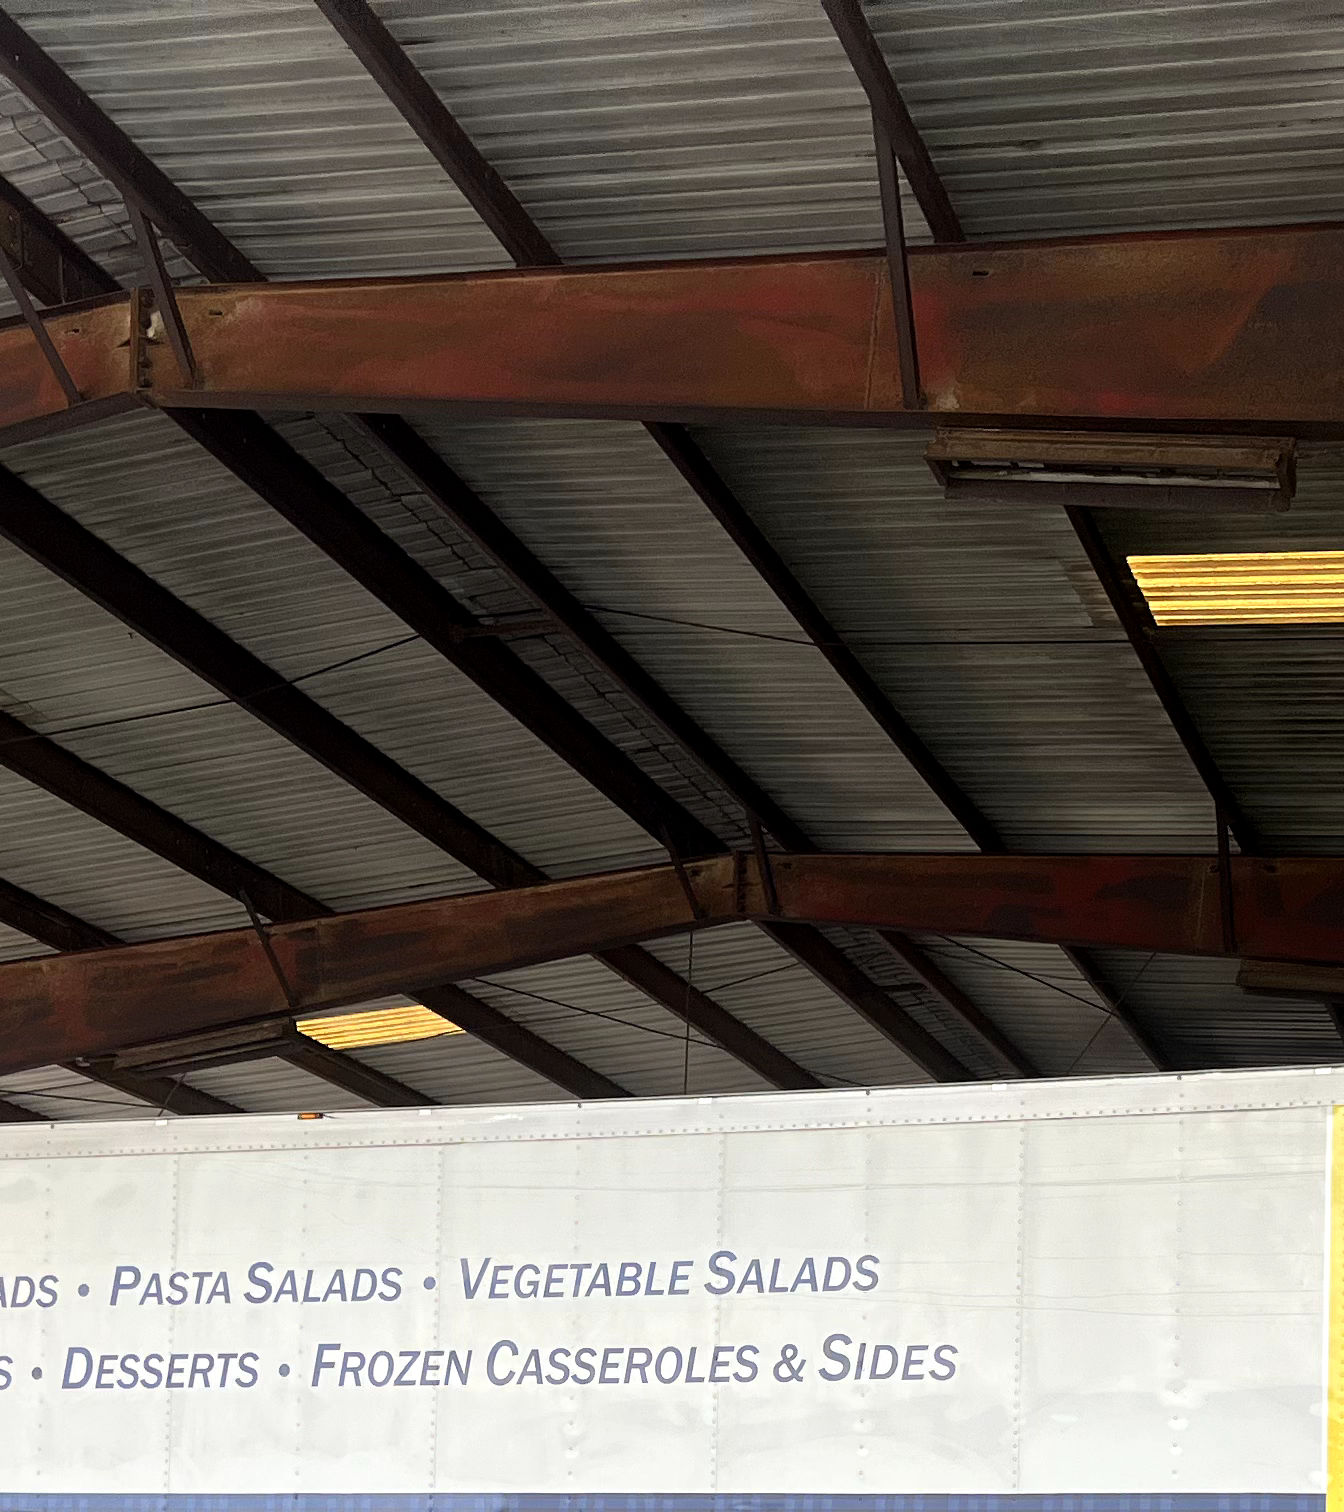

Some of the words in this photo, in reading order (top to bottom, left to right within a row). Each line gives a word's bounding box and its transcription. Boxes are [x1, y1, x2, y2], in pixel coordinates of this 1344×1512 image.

[109, 1265, 232, 1306] PASTA
[243, 1261, 403, 1304] SALADS
[459, 1257, 695, 1300] VEGETABLE
[703, 1250, 880, 1296] SALADS
[61, 1346, 260, 1390] DESSERTS
[311, 1342, 473, 1387] FROZEN
[486, 1339, 760, 1386] CASSEROLES
[772, 1343, 807, 1383] &
[817, 1333, 959, 1382] SIDES
